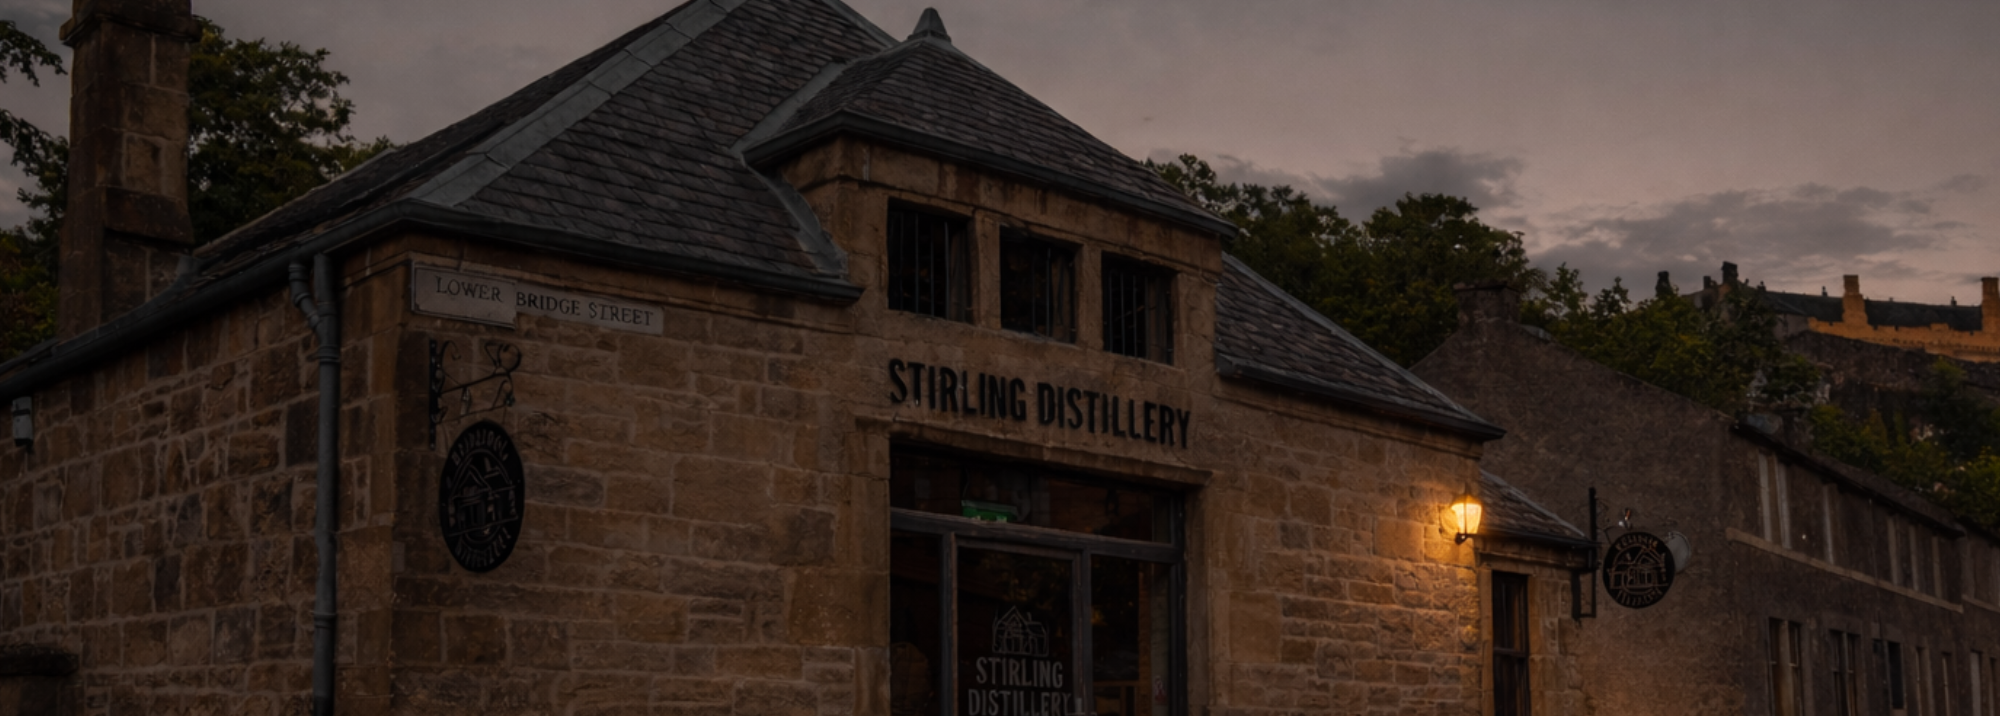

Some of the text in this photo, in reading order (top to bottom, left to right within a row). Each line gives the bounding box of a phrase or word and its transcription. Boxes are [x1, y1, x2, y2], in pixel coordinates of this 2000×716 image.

[435, 275, 654, 326] LOWER BRIDGE STREET
[889, 358, 1191, 448] STIRLING DISTILLERY
[975, 656, 1064, 689] STIRLING
[967, 688, 1072, 716] DISTILLERY
